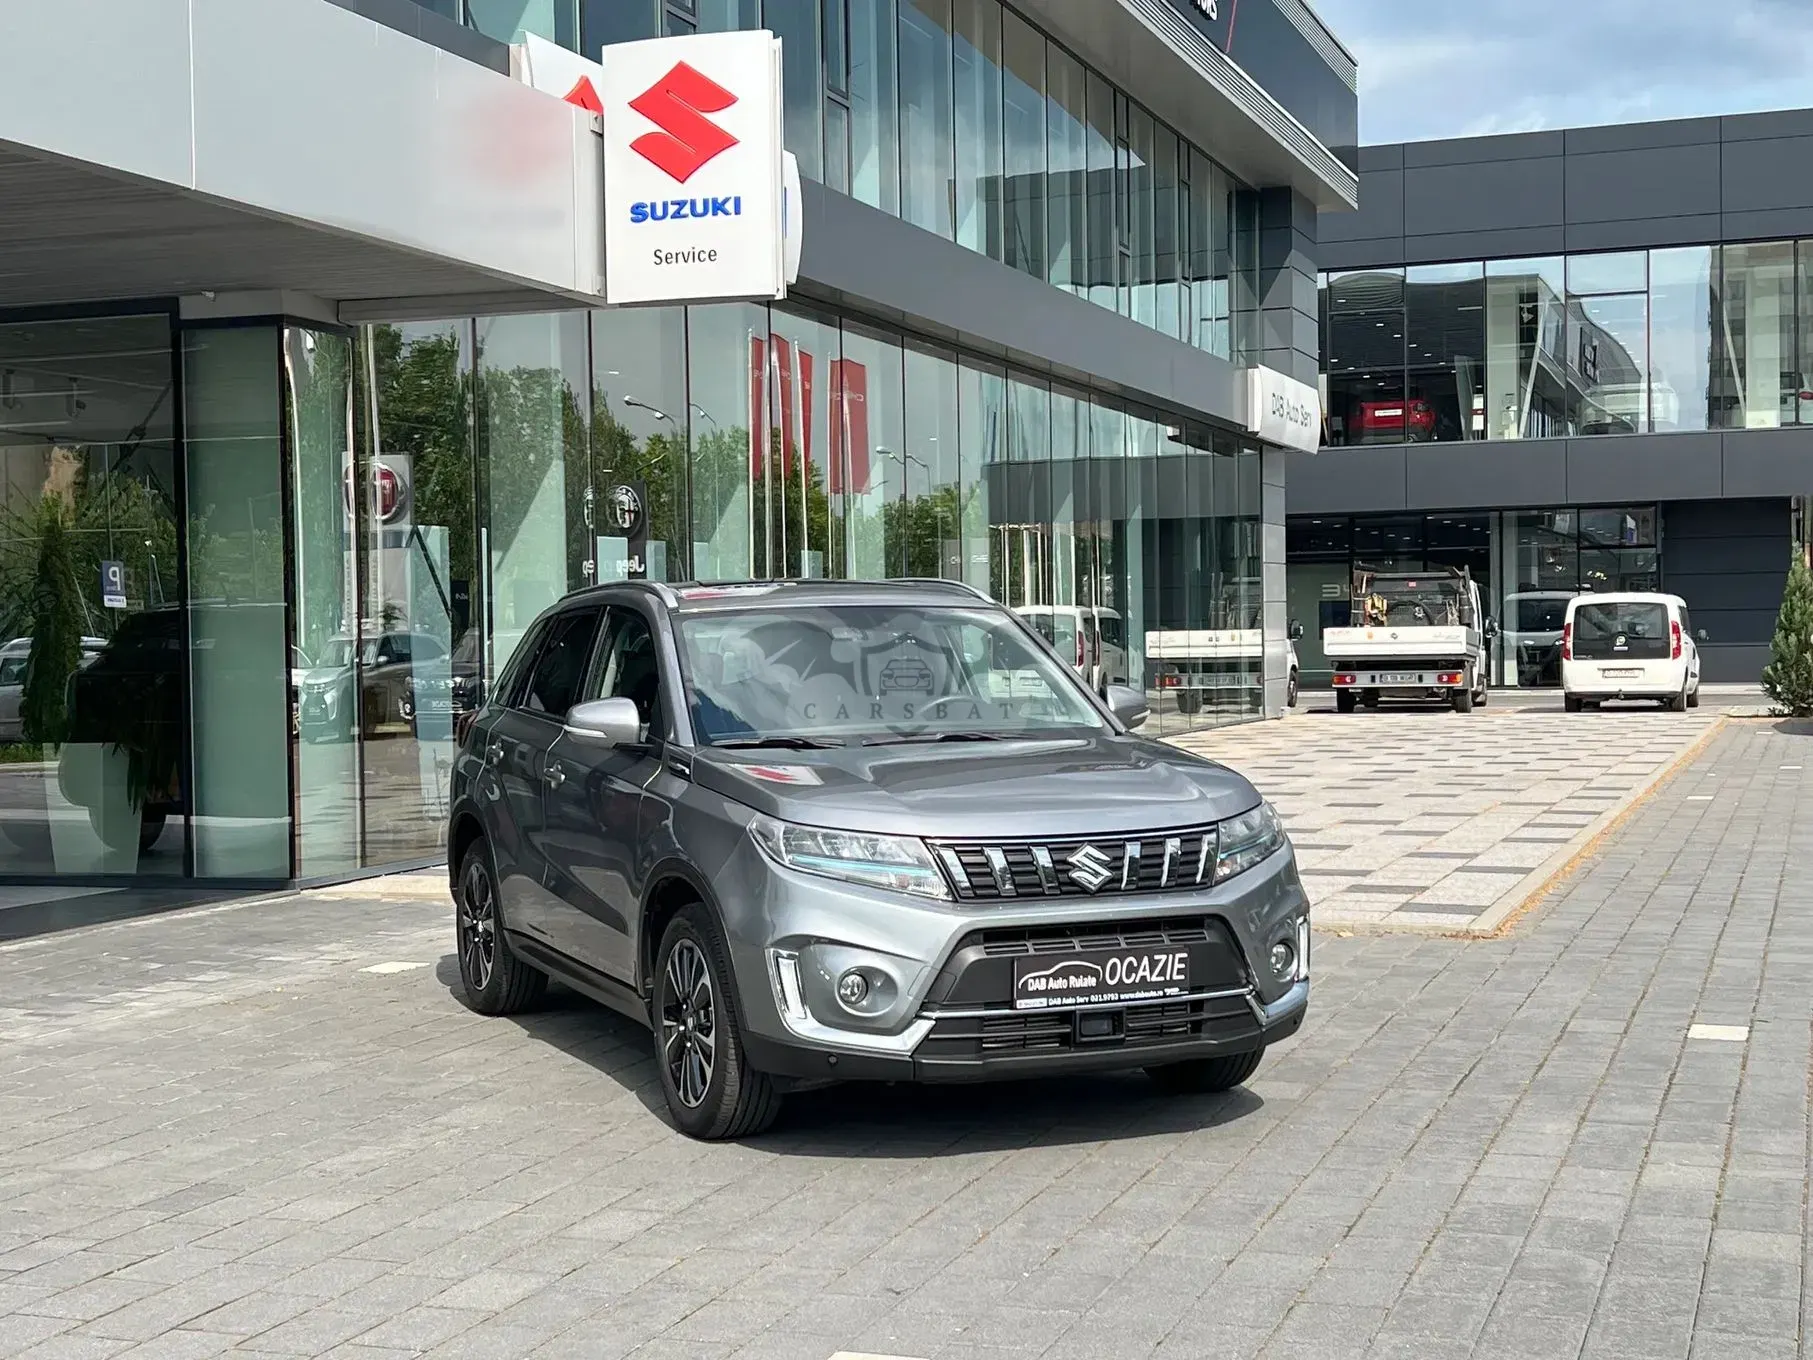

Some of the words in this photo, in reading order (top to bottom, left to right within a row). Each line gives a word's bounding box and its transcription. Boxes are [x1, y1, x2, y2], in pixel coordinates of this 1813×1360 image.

[630, 196, 742, 223] SUZUKI
[653, 246, 718, 266] Service
[1286, 399, 1300, 424] Auto
[1105, 953, 1188, 985] OCAZIE
[1027, 978, 1046, 991] DAB
[1048, 976, 1068, 990] Auto
[1069, 974, 1096, 988] Rulate
[1062, 995, 1076, 1004] Auto
[1076, 994, 1089, 1003] Serv
